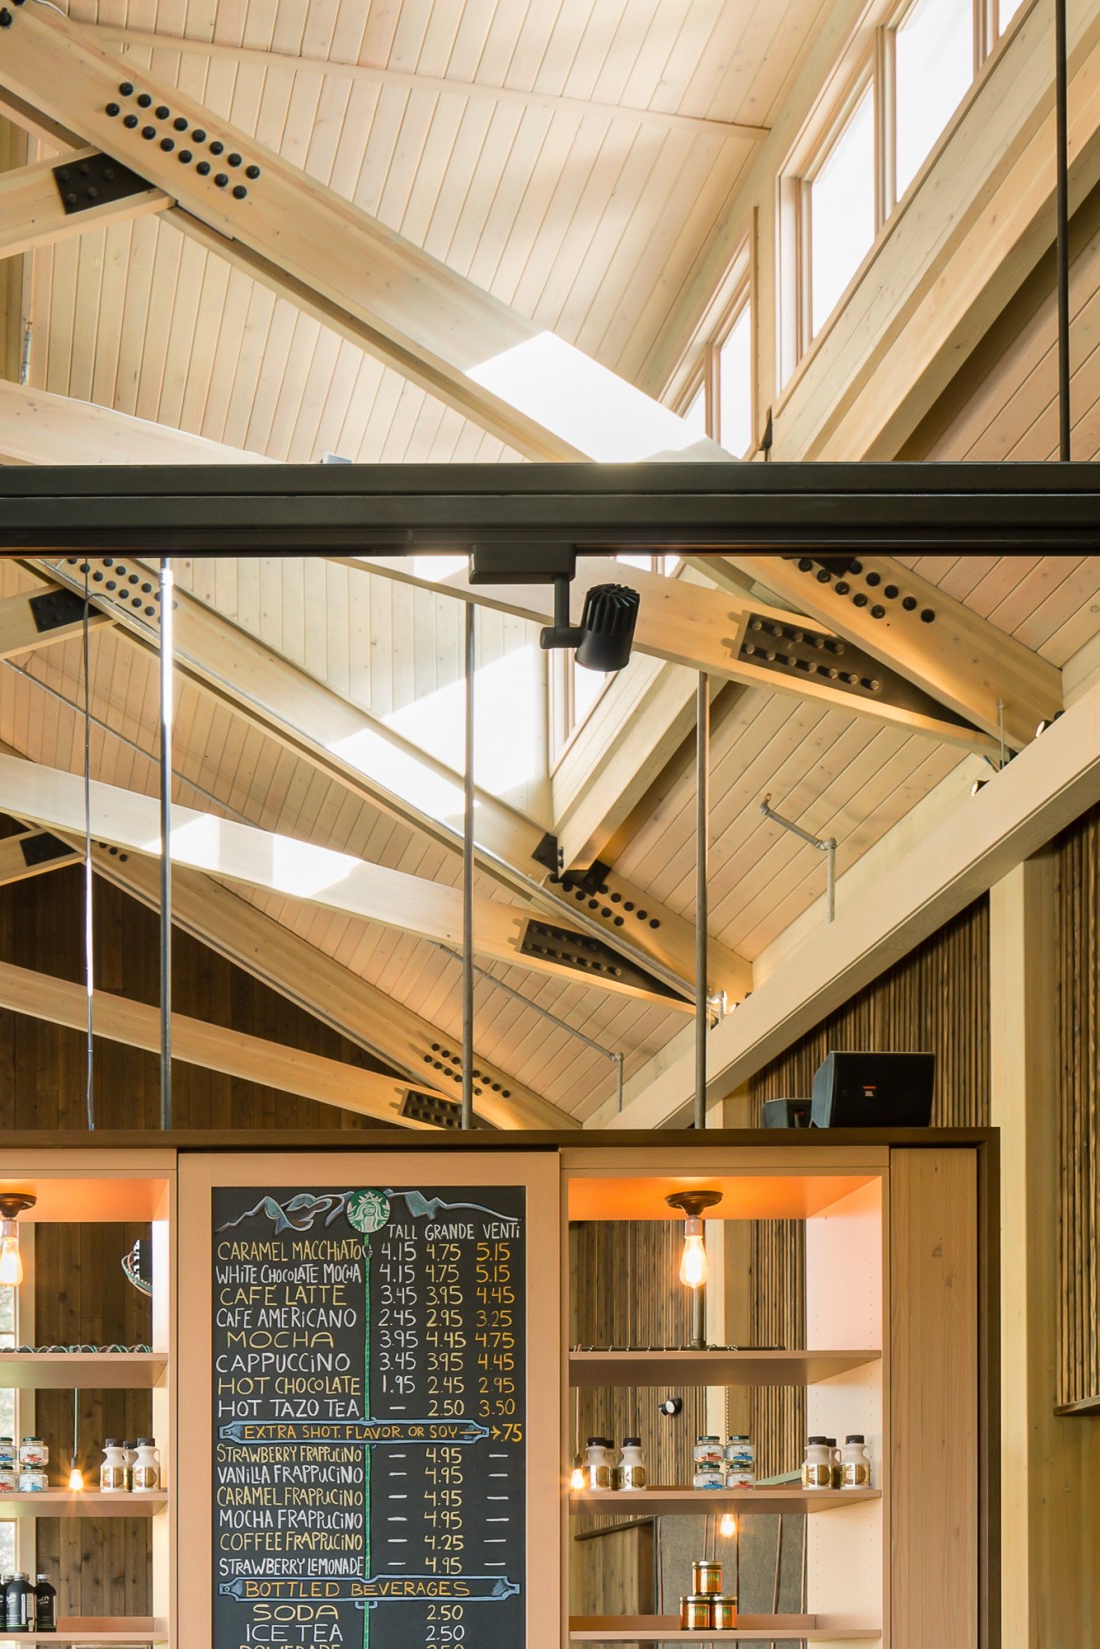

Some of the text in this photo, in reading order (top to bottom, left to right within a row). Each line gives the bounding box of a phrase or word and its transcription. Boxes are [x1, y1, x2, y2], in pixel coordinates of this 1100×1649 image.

[386, 1224, 418, 1240] TALL
[424, 1223, 475, 1241] GRANDE
[217, 1241, 289, 1262] CARAMEL
[381, 1241, 417, 1262] 4.15
[426, 1243, 462, 1262] 4.75
[475, 1242, 511, 1262] 5.15
[323, 1263, 362, 1284] MOCHA
[379, 1263, 416, 1284] 4.15
[425, 1264, 460, 1283] 4.75
[475, 1264, 511, 1283] 5.15
[285, 1284, 348, 1306] LATTE
[380, 1284, 418, 1306] 3.45
[425, 1285, 464, 1306] 3.95
[475, 1286, 516, 1305] 4.45
[377, 1308, 417, 1327] 2.45
[426, 1309, 464, 1328] 2.95
[475, 1309, 513, 1328] 3.25
[227, 1329, 516, 1349] MOCHA 3.95 4.45 4.75
[379, 1351, 417, 1371] 3.45
[427, 1352, 464, 1372] 3.95
[477, 1352, 516, 1371] 4.45
[217, 1376, 271, 1396] HOT
[382, 1374, 416, 1395] 1.95
[427, 1376, 465, 1394] 2.45
[478, 1377, 516, 1394] 2.95
[217, 1398, 516, 1418] HOT TAZO TEA 2.50 3.50
[244, 1425, 297, 1440] EXTRA
[407, 1426, 425, 1438] OR
[429, 1425, 458, 1439] SOY
[216, 1443, 298, 1463] STRAWBERRY
[425, 1447, 463, 1464] 4.95
[424, 1465, 464, 1485] 4.95
[216, 1486, 283, 1507] CARAMEL
[423, 1490, 463, 1508] 4.95
[219, 1509, 274, 1529] MOCHA
[423, 1510, 463, 1530] 4.95
[219, 1532, 283, 1551] COFFEE
[424, 1534, 465, 1551] 4.25
[219, 1556, 463, 1576] STRAWBERRY LEMONADE 4.95
[245, 1580, 471, 1598] BOTTLED BEVERAGES
[252, 1603, 464, 1622] SODA 2.50
[295, 1623, 344, 1642] TEA
[425, 1624, 465, 1642] 2.50
